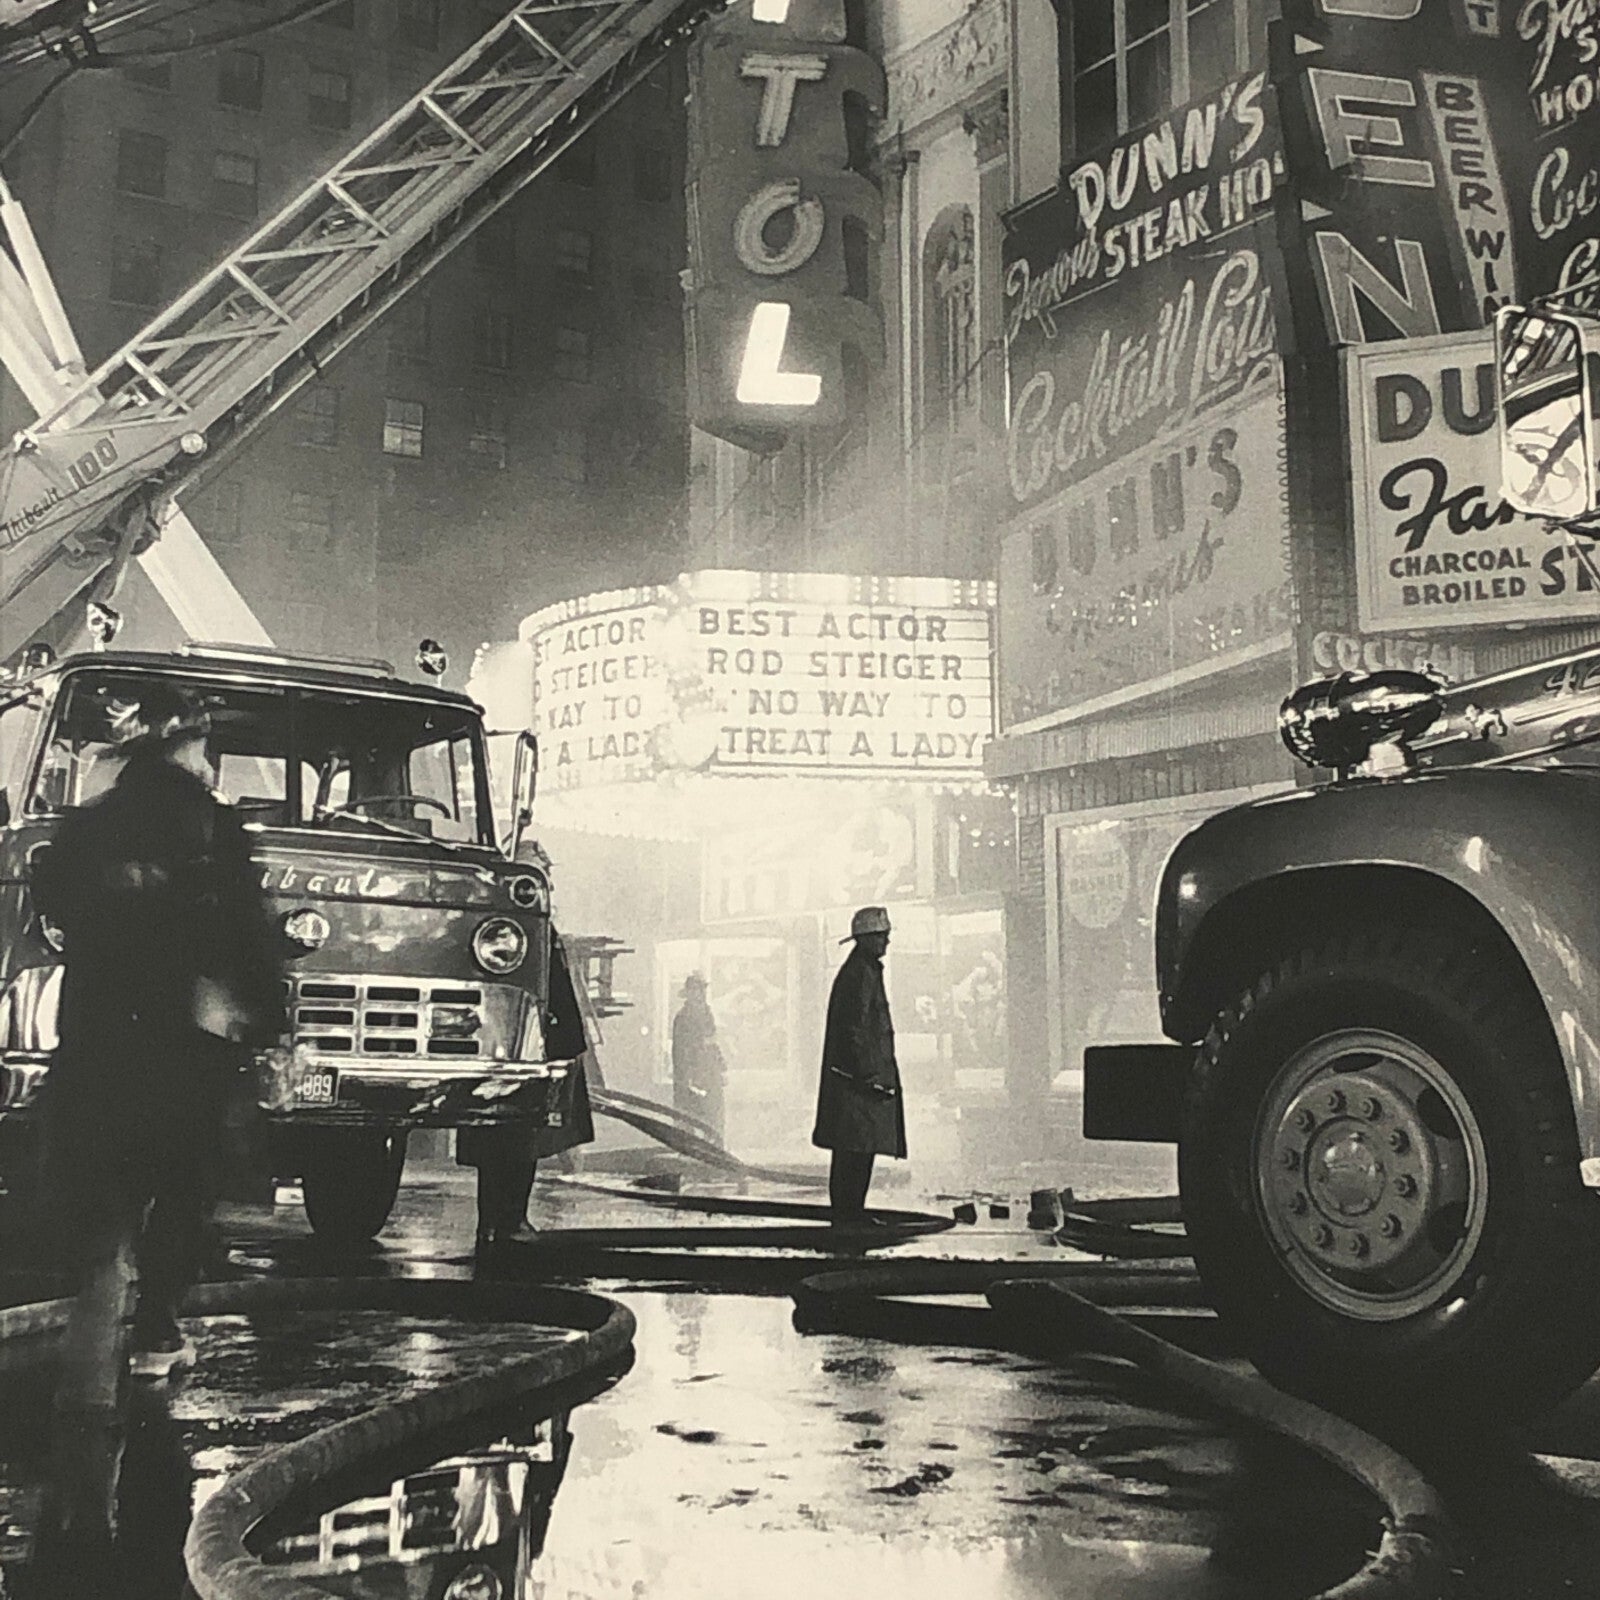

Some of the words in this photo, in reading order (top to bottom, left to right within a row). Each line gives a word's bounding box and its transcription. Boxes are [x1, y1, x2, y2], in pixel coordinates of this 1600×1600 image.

[1068, 71, 1266, 230] DUNN'S
[1435, 81, 1498, 216] BEER
[1308, 0, 1442, 344] EN
[733, 0, 829, 406] TOL
[1104, 185, 1212, 278] STEAK
[1379, 457, 1545, 552] Fa
[1388, 546, 1532, 579] CHARCOAL
[1402, 576, 1526, 606] BROILED
[563, 617, 646, 655] ACTOR
[699, 607, 798, 637] BEST
[816, 612, 947, 643] ACTOR
[707, 648, 784, 677] ROD
[807, 651, 963, 681] STEIGER
[603, 694, 642, 721] TO
[818, 690, 891, 718] WAY
[917, 691, 967, 720] TO
[557, 740, 573, 767] A
[720, 726, 832, 755] TREAT
[848, 731, 874, 758] A
[890, 732, 980, 759] LADY
